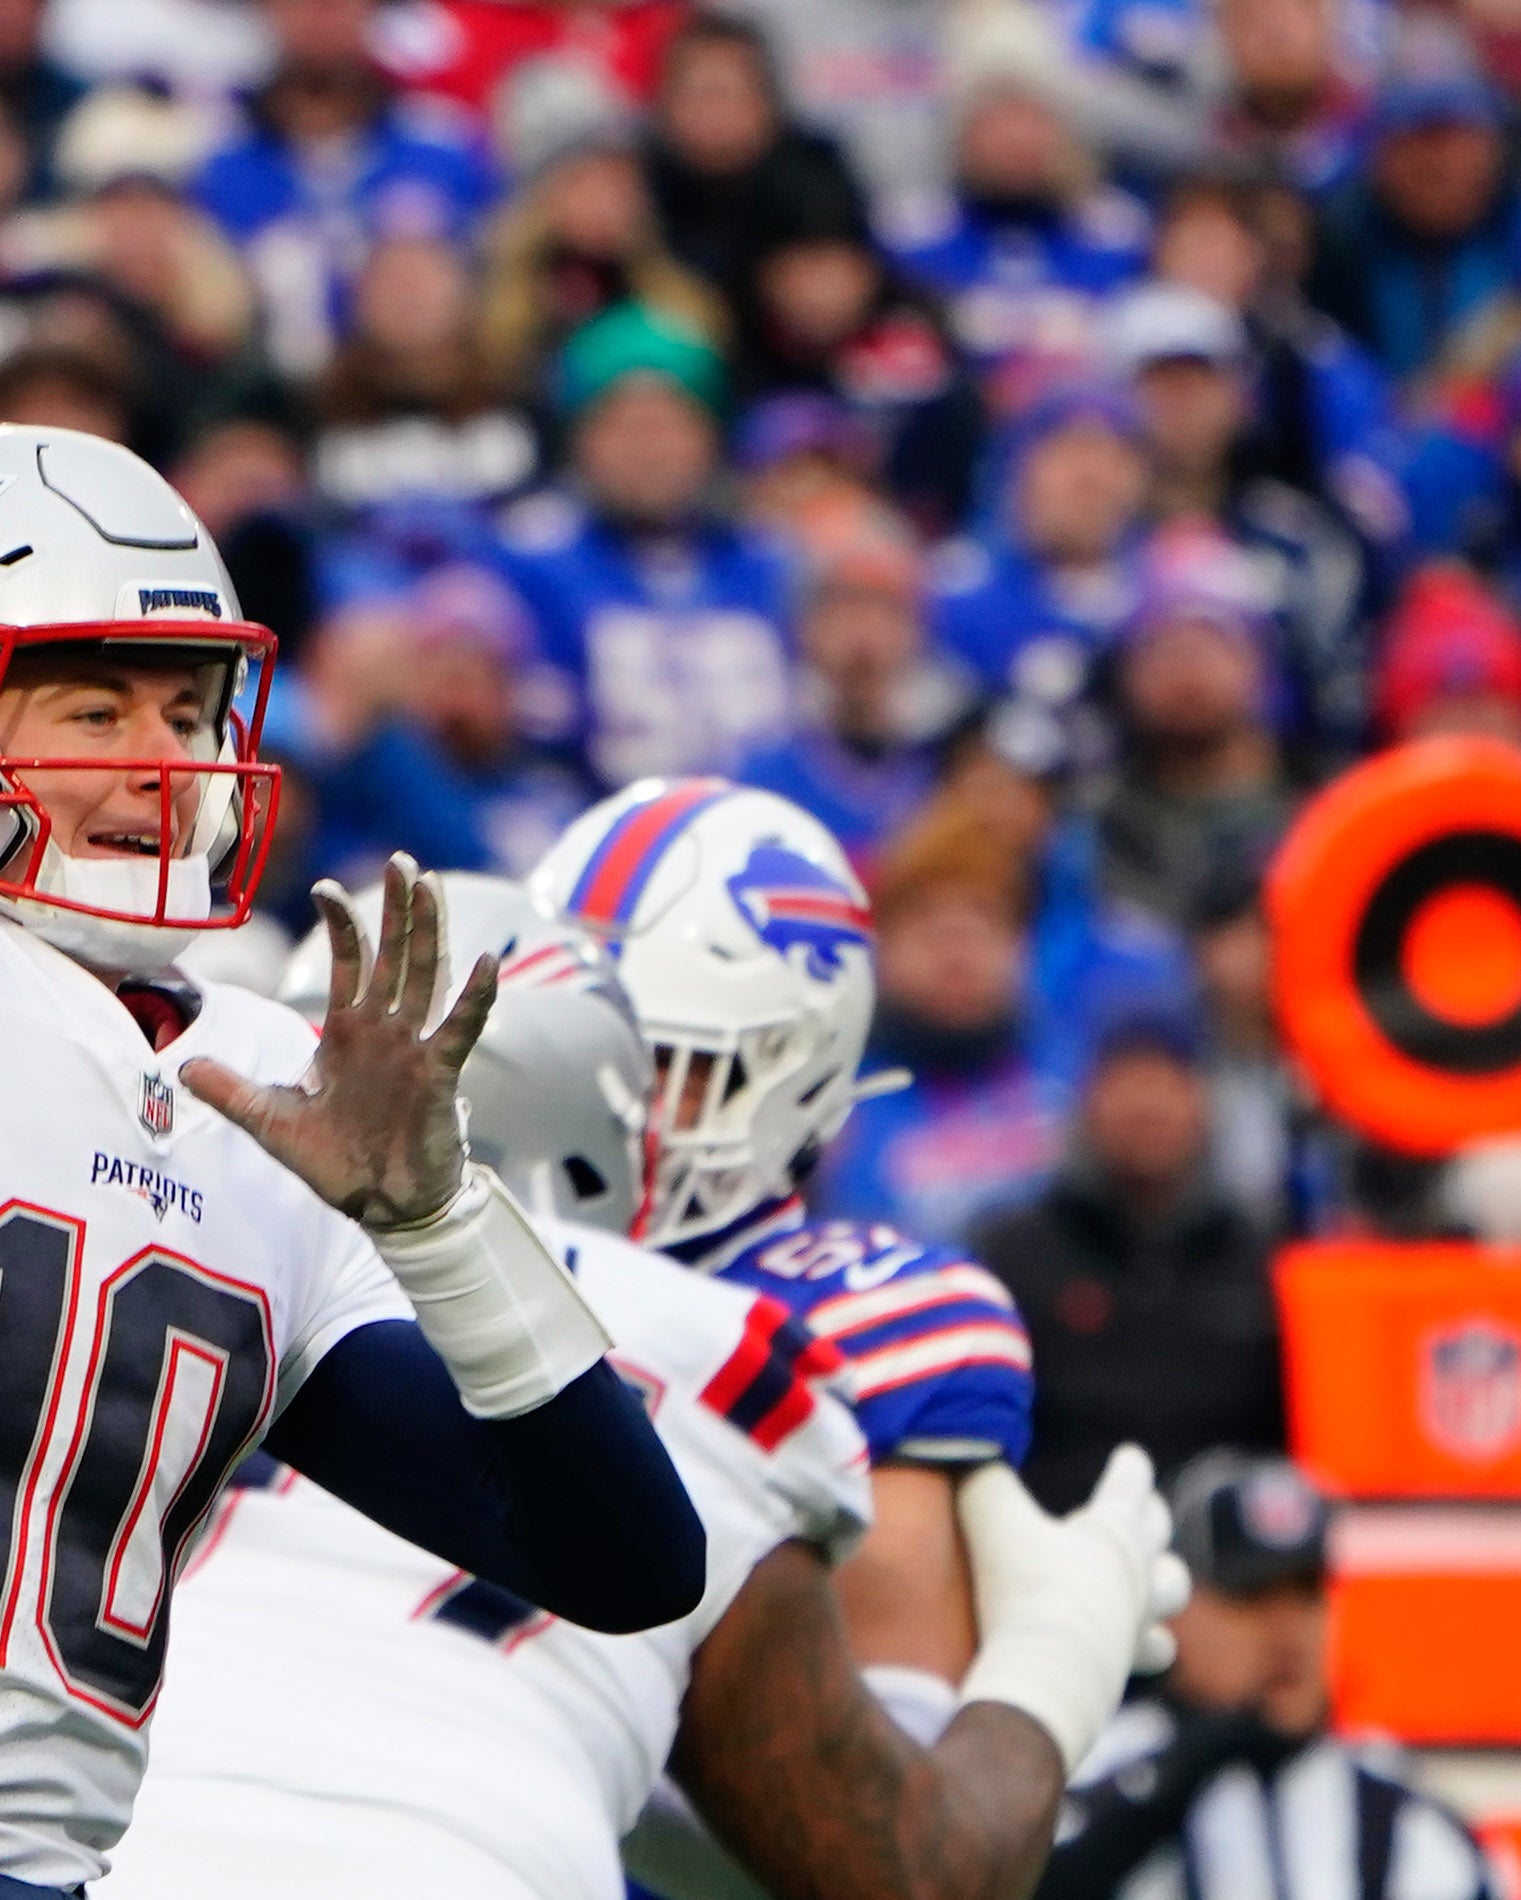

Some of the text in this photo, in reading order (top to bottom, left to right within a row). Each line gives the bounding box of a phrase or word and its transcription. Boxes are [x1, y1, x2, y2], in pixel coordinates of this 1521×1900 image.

[138, 589, 222, 618] PATRIOTS
[146, 1097, 170, 1128] NFL
[90, 1150, 204, 1225] PATRIOTS
